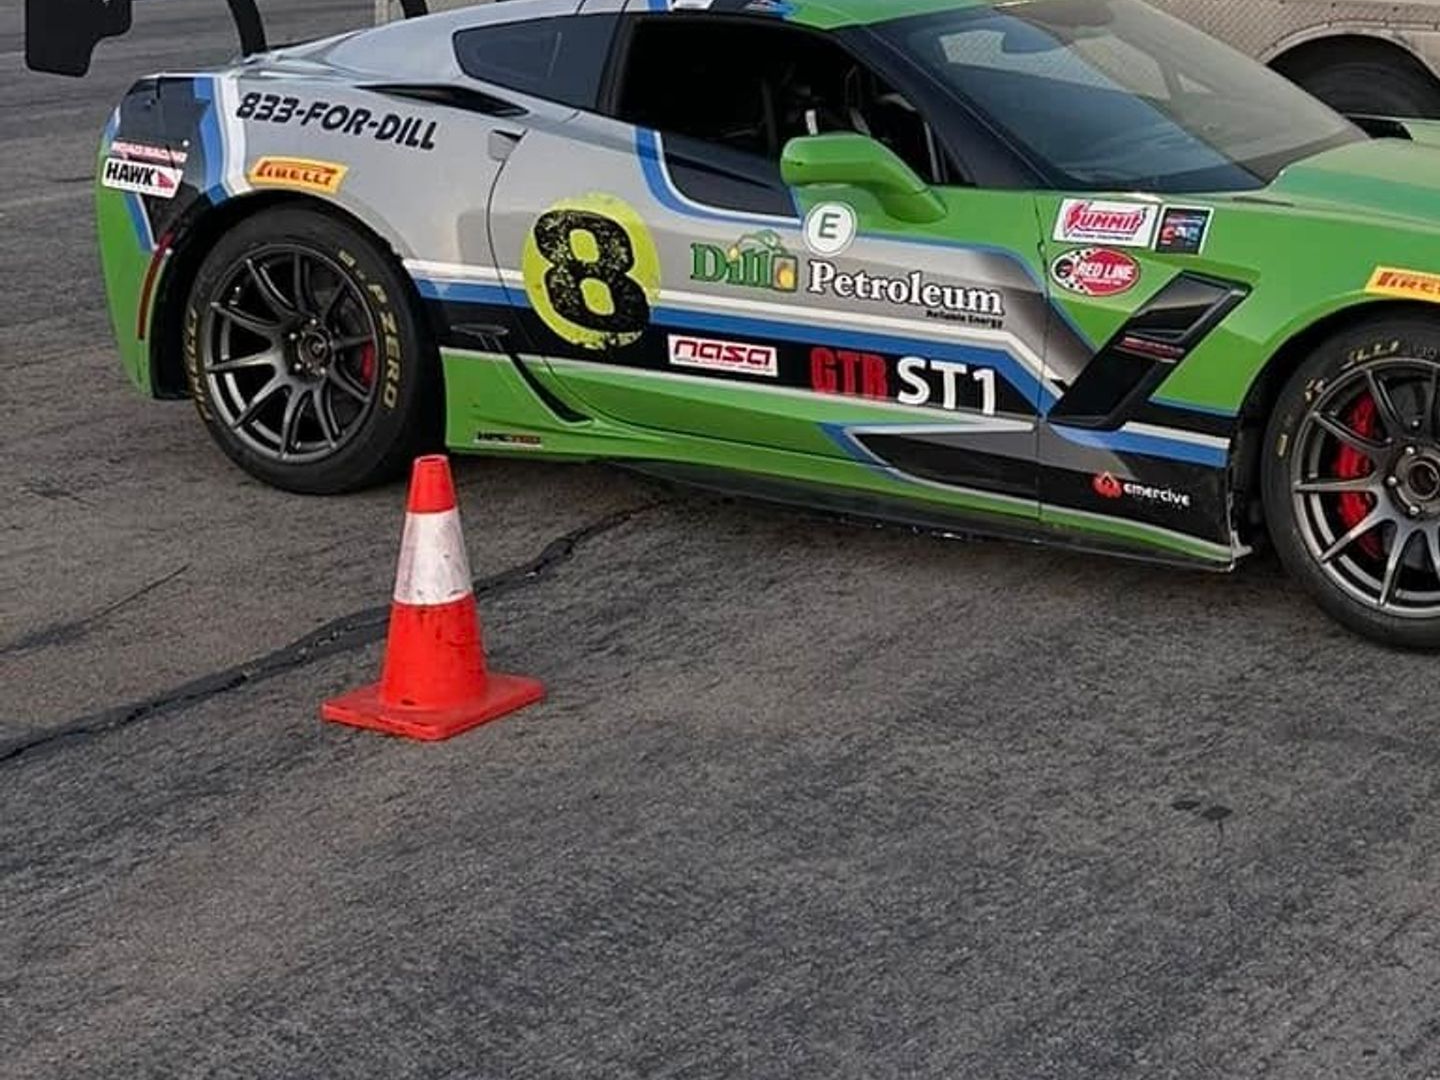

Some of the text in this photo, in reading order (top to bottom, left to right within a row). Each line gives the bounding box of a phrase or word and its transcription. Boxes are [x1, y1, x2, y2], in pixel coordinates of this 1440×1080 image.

[236, 92, 437, 150] 833-FOR-DILL
[106, 161, 155, 186] HAWK
[256, 161, 337, 185] PIRELLI
[818, 212, 841, 240] E
[533, 209, 650, 332] 8
[807, 260, 1005, 316] Petroleum
[1078, 262, 1135, 280] RED LINE
[898, 356, 996, 415] ST1
